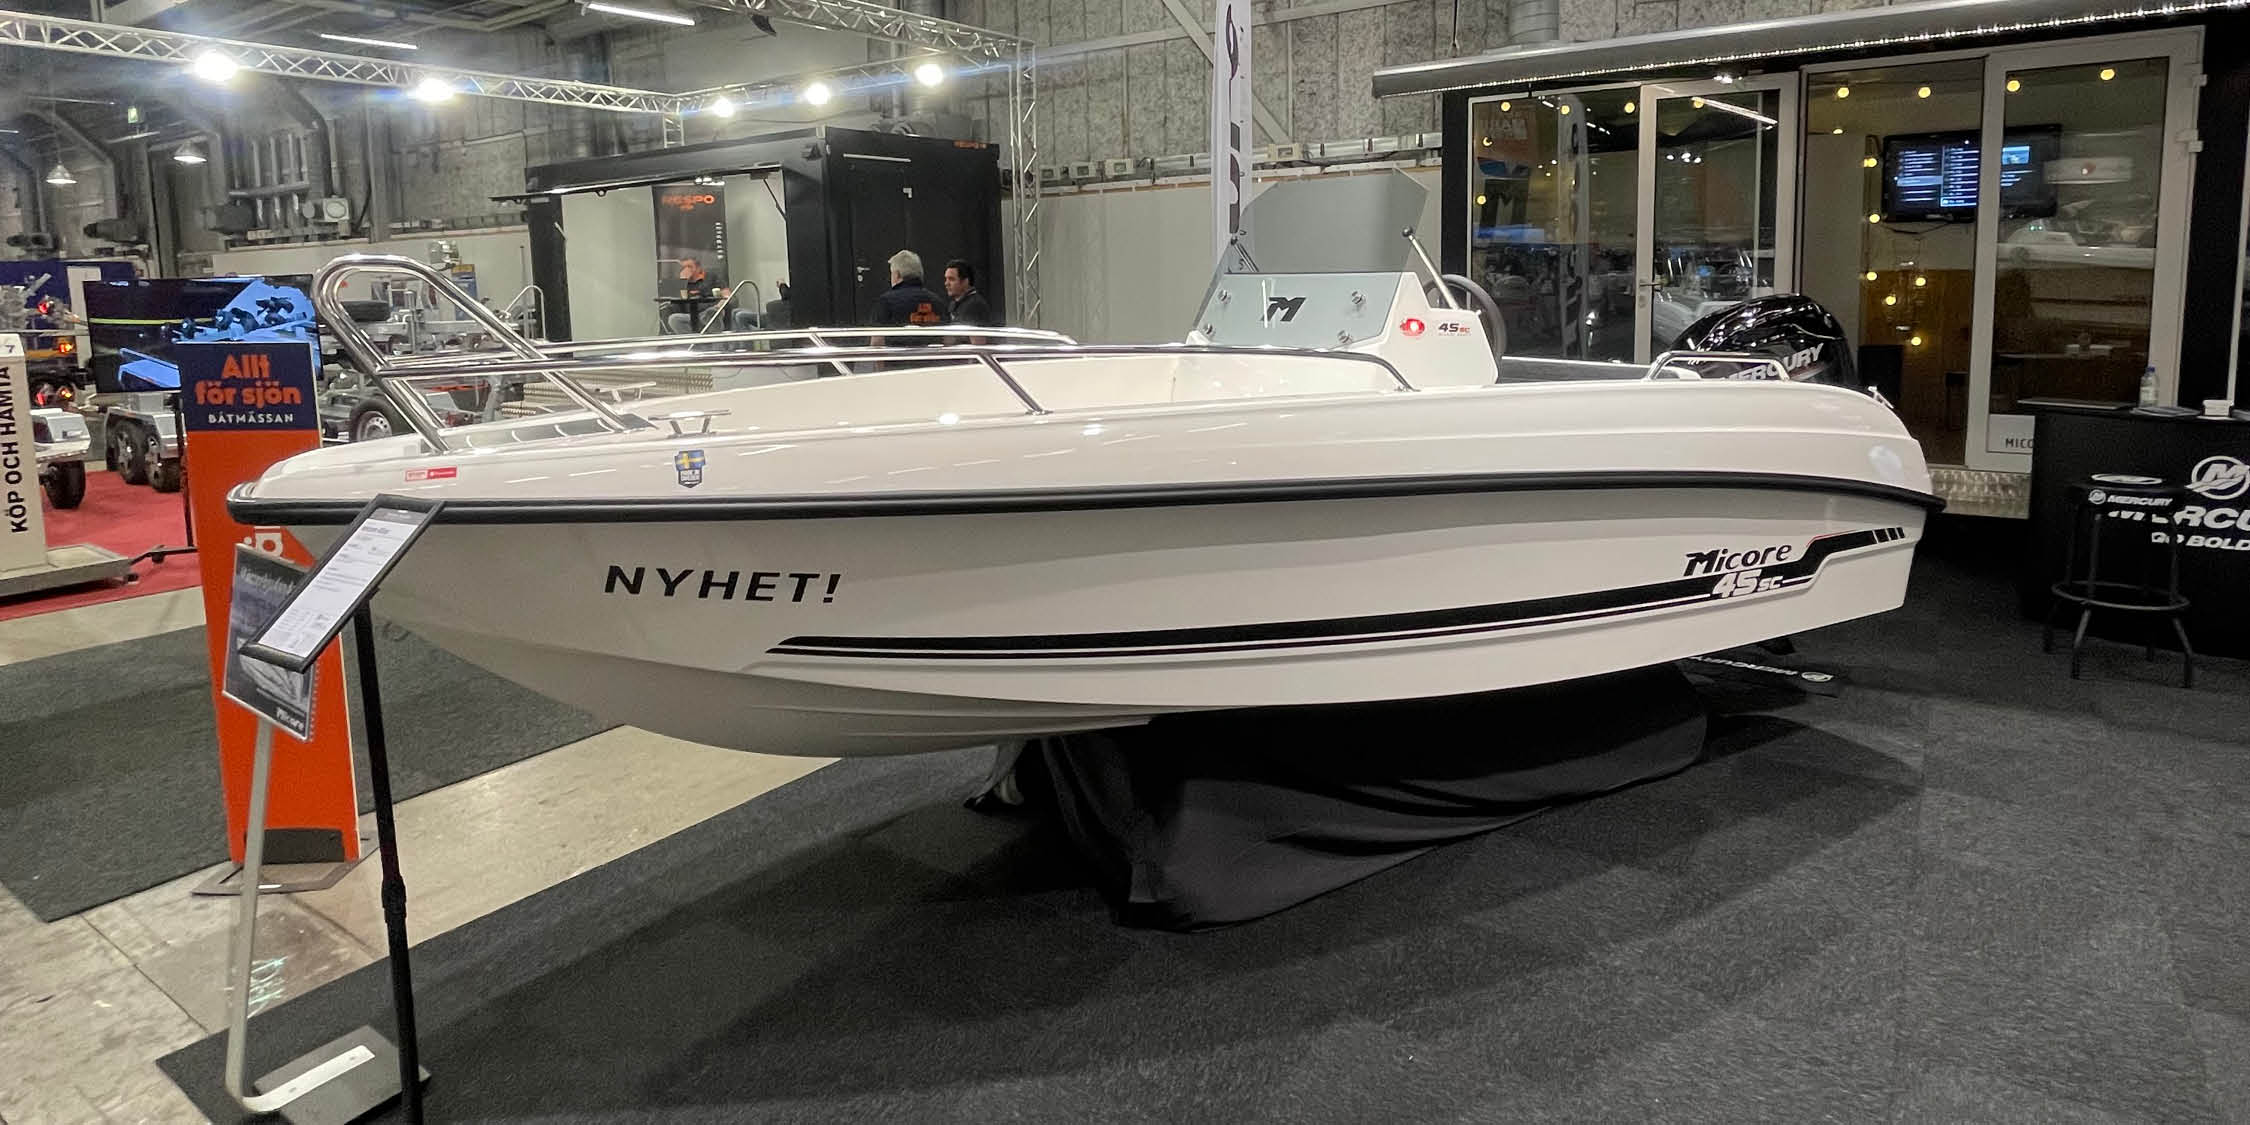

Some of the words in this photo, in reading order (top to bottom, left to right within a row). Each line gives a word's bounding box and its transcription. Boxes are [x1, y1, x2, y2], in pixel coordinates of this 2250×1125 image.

[221, 353, 270, 379] Allt
[194, 380, 237, 405] för
[241, 380, 302, 409] sjön
[208, 411, 294, 424] BÅTMÄSSAN
[2, 441, 22, 485] OCH
[5, 491, 29, 533] KÖP
[2107, 495, 2173, 506] MERCURY
[2186, 535, 2250, 551] BOLD
[1683, 544, 1792, 577] Micore
[604, 565, 841, 603] NYHET!
